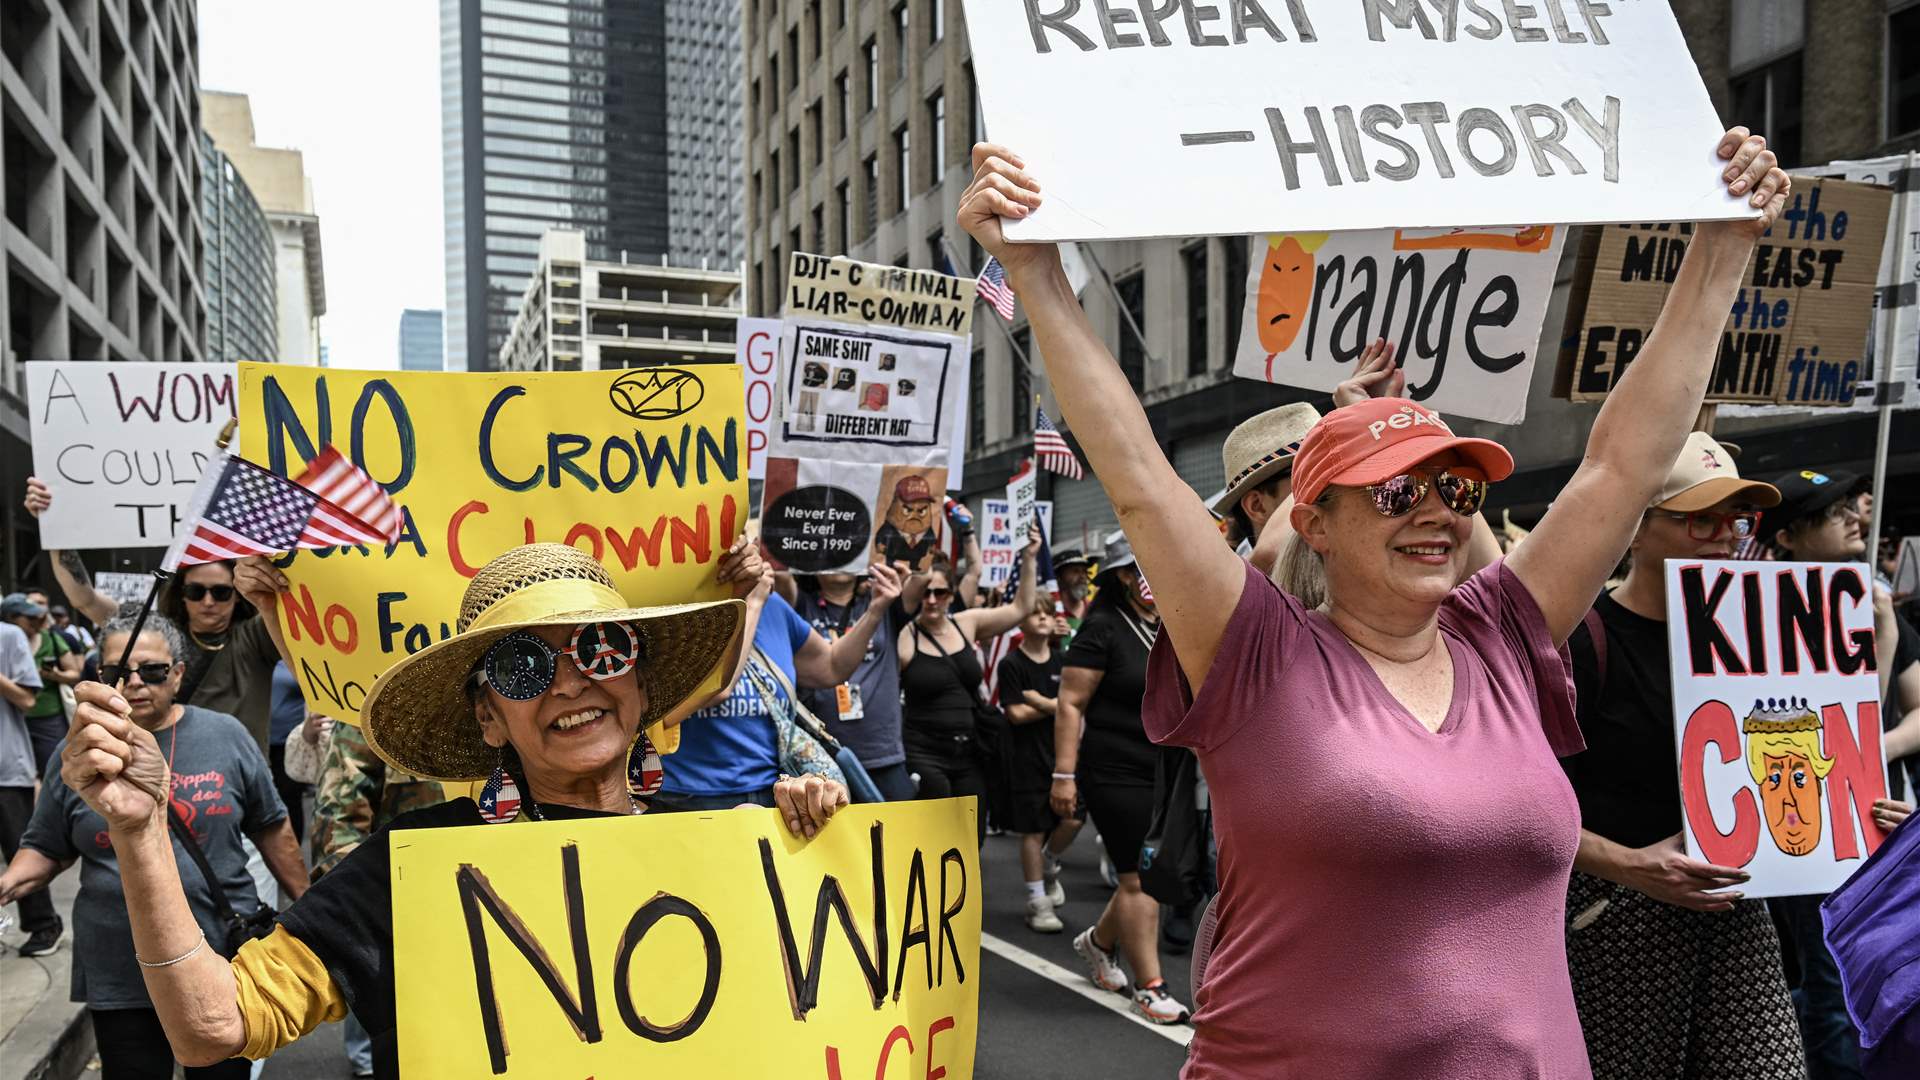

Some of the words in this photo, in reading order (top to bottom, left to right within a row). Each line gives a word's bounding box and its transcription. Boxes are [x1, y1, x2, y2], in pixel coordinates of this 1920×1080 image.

[1264, 95, 1621, 191] HISTORY
[1784, 186, 1848, 241] the
[848, 263, 963, 301] CIMINAL
[1620, 236, 1686, 283] MID
[1752, 245, 1844, 290] EAST
[1731, 288, 1789, 330] the
[805, 335, 840, 358] SAME
[842, 339, 872, 362] SHIT
[44, 369, 89, 424] A
[108, 370, 237, 423] WOM
[1786, 345, 1858, 404] time
[746, 331, 773, 470] GOP
[262, 375, 416, 494] NO
[478, 384, 738, 493] CROWN
[825, 413, 889, 437] DIFFERENT
[890, 419, 912, 437] HAT
[784, 505, 824, 520] Never
[828, 508, 856, 521] Ever
[802, 522, 835, 535] Ever!
[781, 536, 818, 550] Since
[822, 538, 851, 551] 1990
[982, 549, 1012, 564] EPST
[1679, 564, 1878, 677] KING
